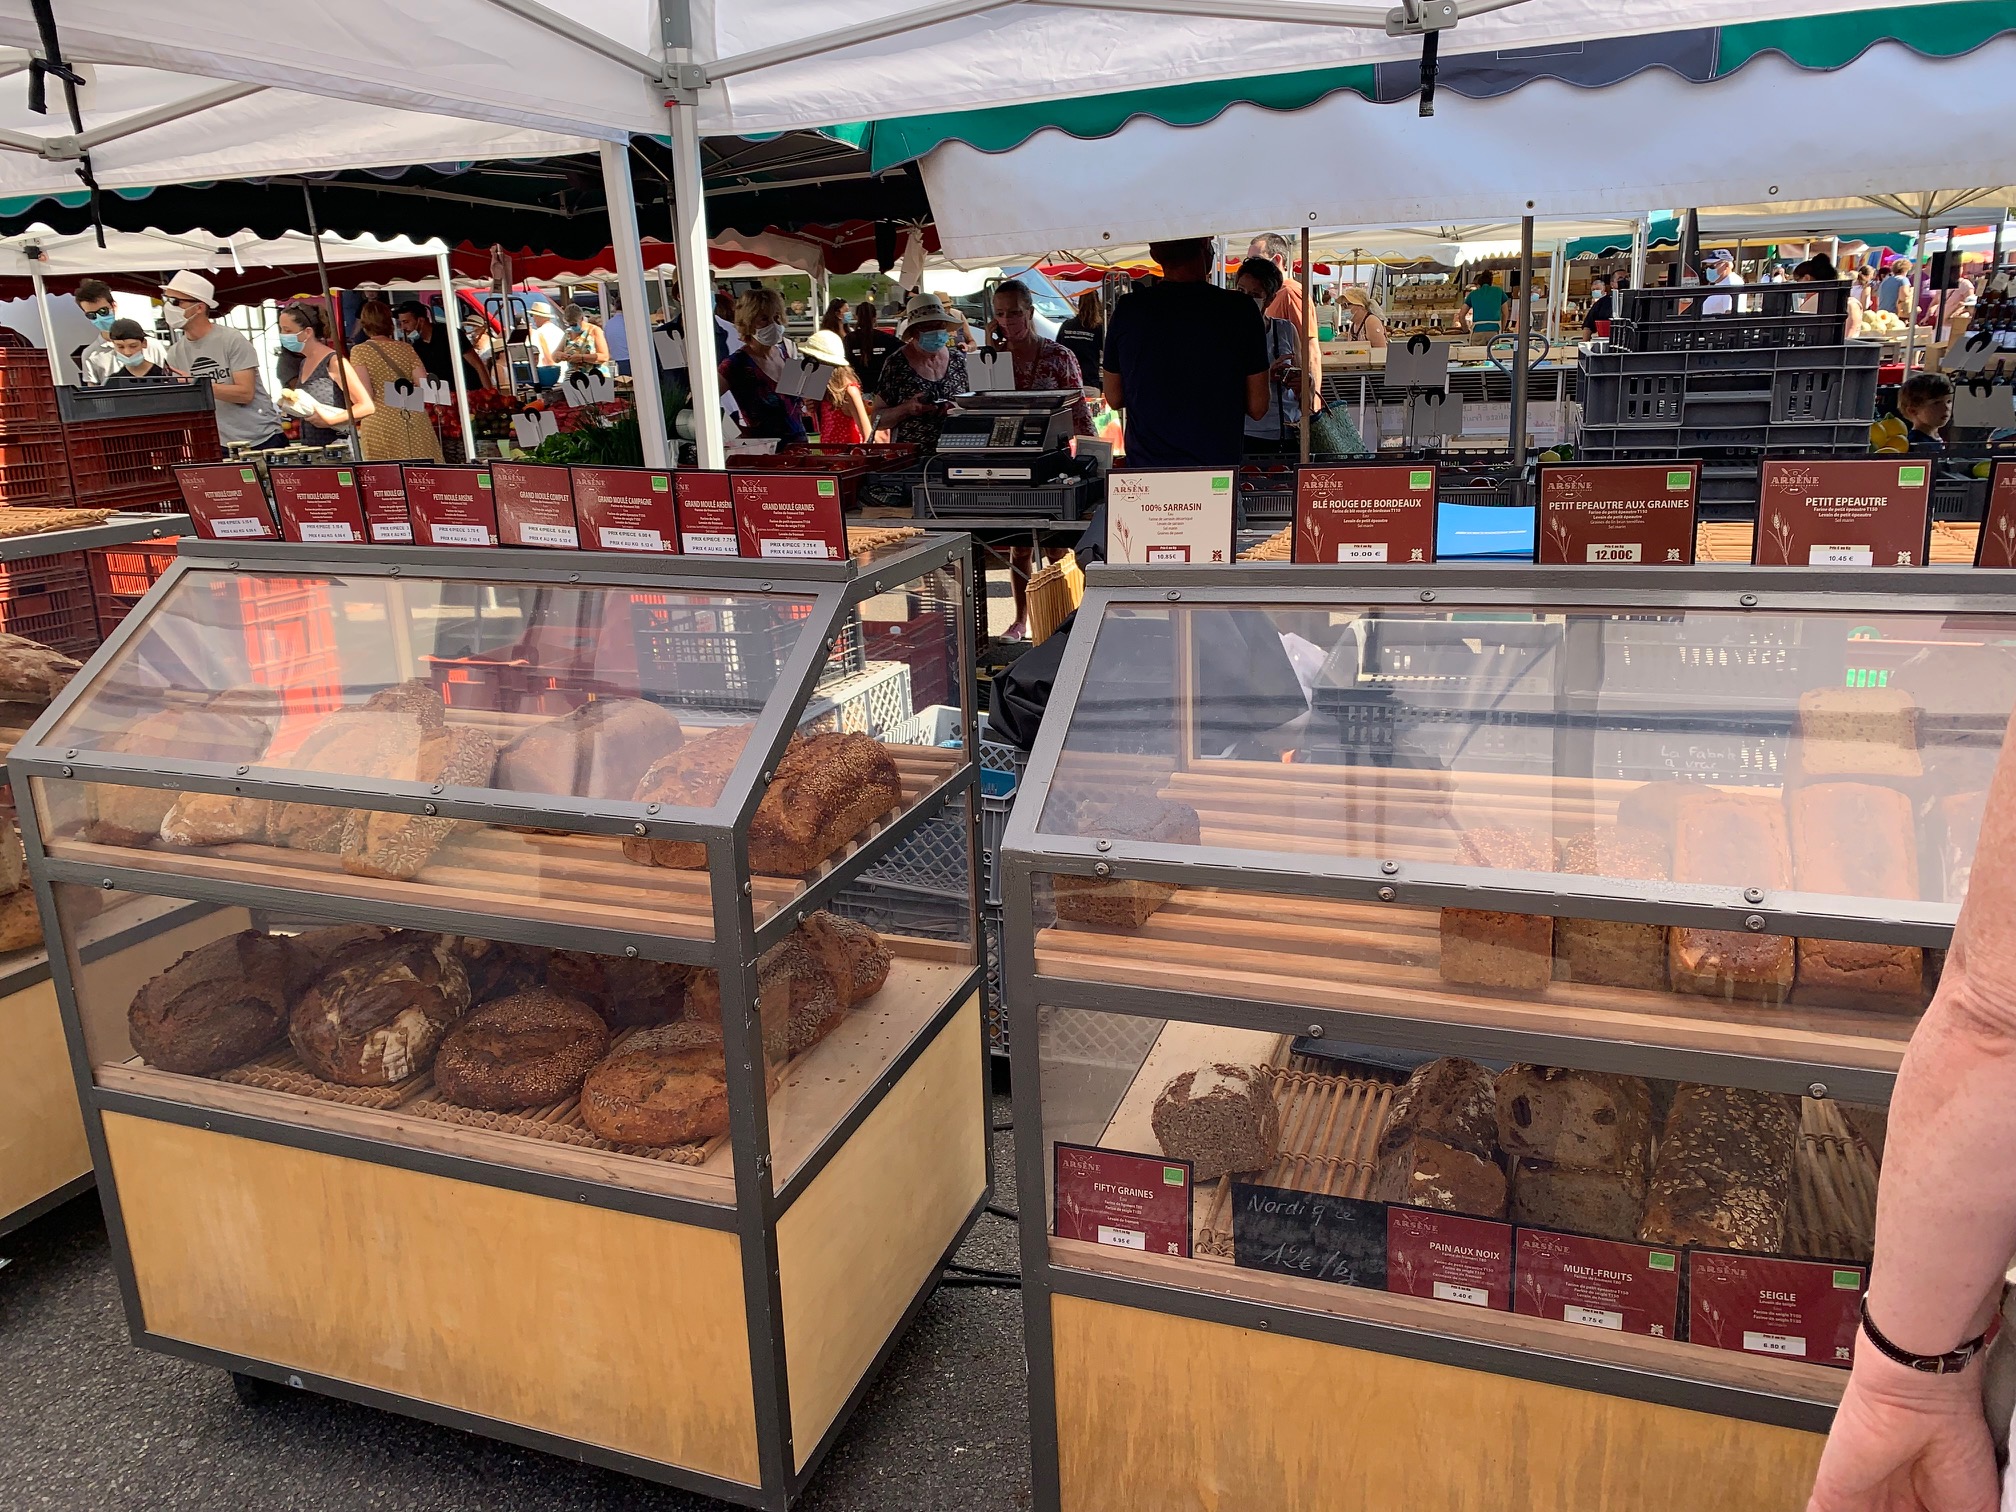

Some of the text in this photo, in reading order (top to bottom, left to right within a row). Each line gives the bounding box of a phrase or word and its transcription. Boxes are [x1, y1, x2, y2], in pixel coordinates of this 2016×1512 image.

[1302, 480, 1344, 488] ARSÈNE
[1548, 480, 1593, 489] ARSÈNE
[1770, 475, 1820, 484] ARSÈNE
[736, 485, 768, 493] ARSÈNE
[1114, 484, 1150, 493] ARSÈNE
[535, 492, 549, 500] MOULÉ
[550, 493, 569, 502] COMPLET
[613, 496, 628, 504] MOULÉ
[1806, 497, 1888, 507] PETIT EPEAUTRE
[701, 500, 716, 508] MOULÉ
[779, 502, 795, 511] MOULÉ
[1163, 503, 1202, 511] SARRASIN
[1312, 499, 1422, 508] BLÉ ROUGE DE BORDEAUX
[1549, 499, 1689, 510] PETIT EPEAUTRE AUX GRAINES
[1595, 550, 1633, 560] 12.00€
[1062, 1160, 1101, 1172] ARSÈNE
[1094, 1182, 1154, 1199] FIFTY GRAINES
[1393, 1219, 1438, 1232] ARSÈNE
[1429, 1242, 1500, 1260] PAIN AUX NOIX
[1522, 1240, 1570, 1253] ARSÈNE
[1563, 1264, 1633, 1281] MULTI-FRUITS
[1697, 1265, 1748, 1276] ARSÈNE
[1760, 1290, 1796, 1302] SEIGLE
